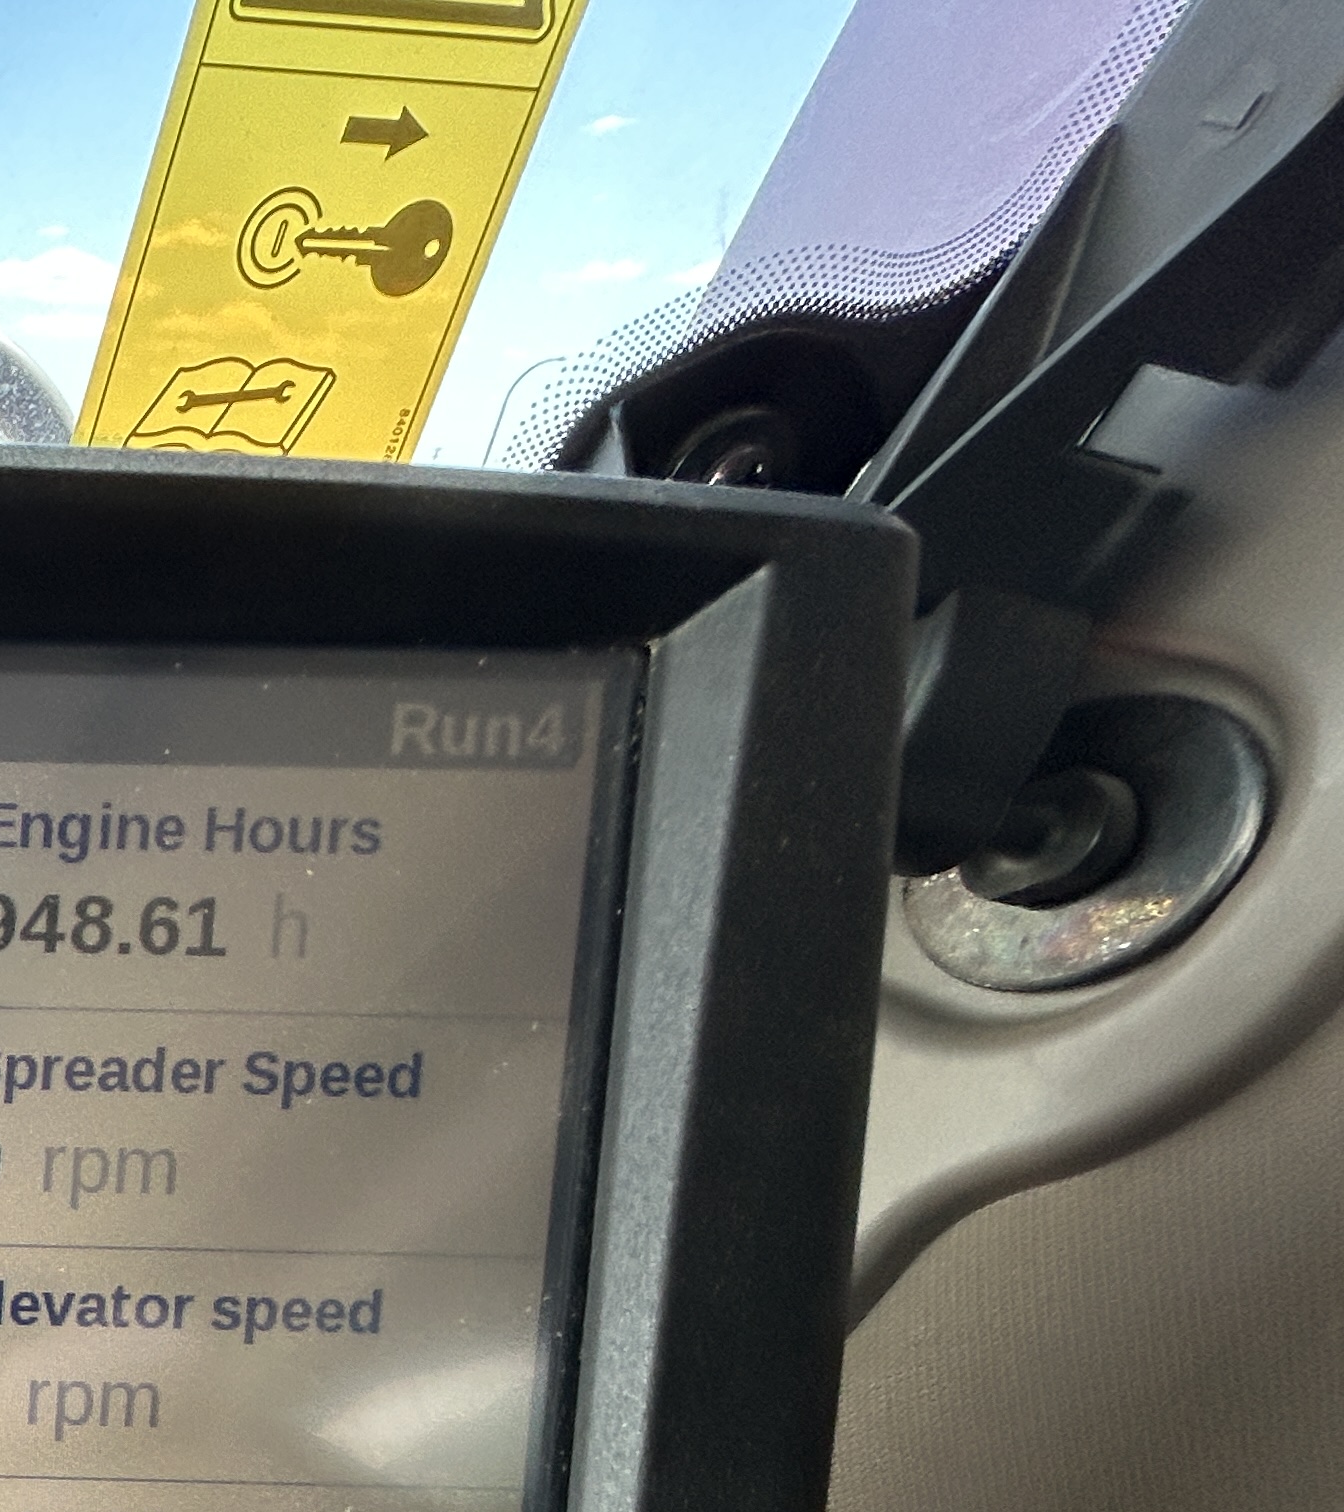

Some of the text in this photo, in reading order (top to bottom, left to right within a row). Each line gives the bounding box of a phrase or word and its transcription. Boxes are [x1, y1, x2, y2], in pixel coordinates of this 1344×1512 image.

[389, 701, 566, 758] Run4
[205, 807, 383, 856] Hours
[271, 893, 310, 959] h
[242, 1050, 425, 1109] Speed
[43, 1145, 177, 1210] rpm
[211, 1288, 384, 1345] speed
[27, 1378, 160, 1442] rpm
